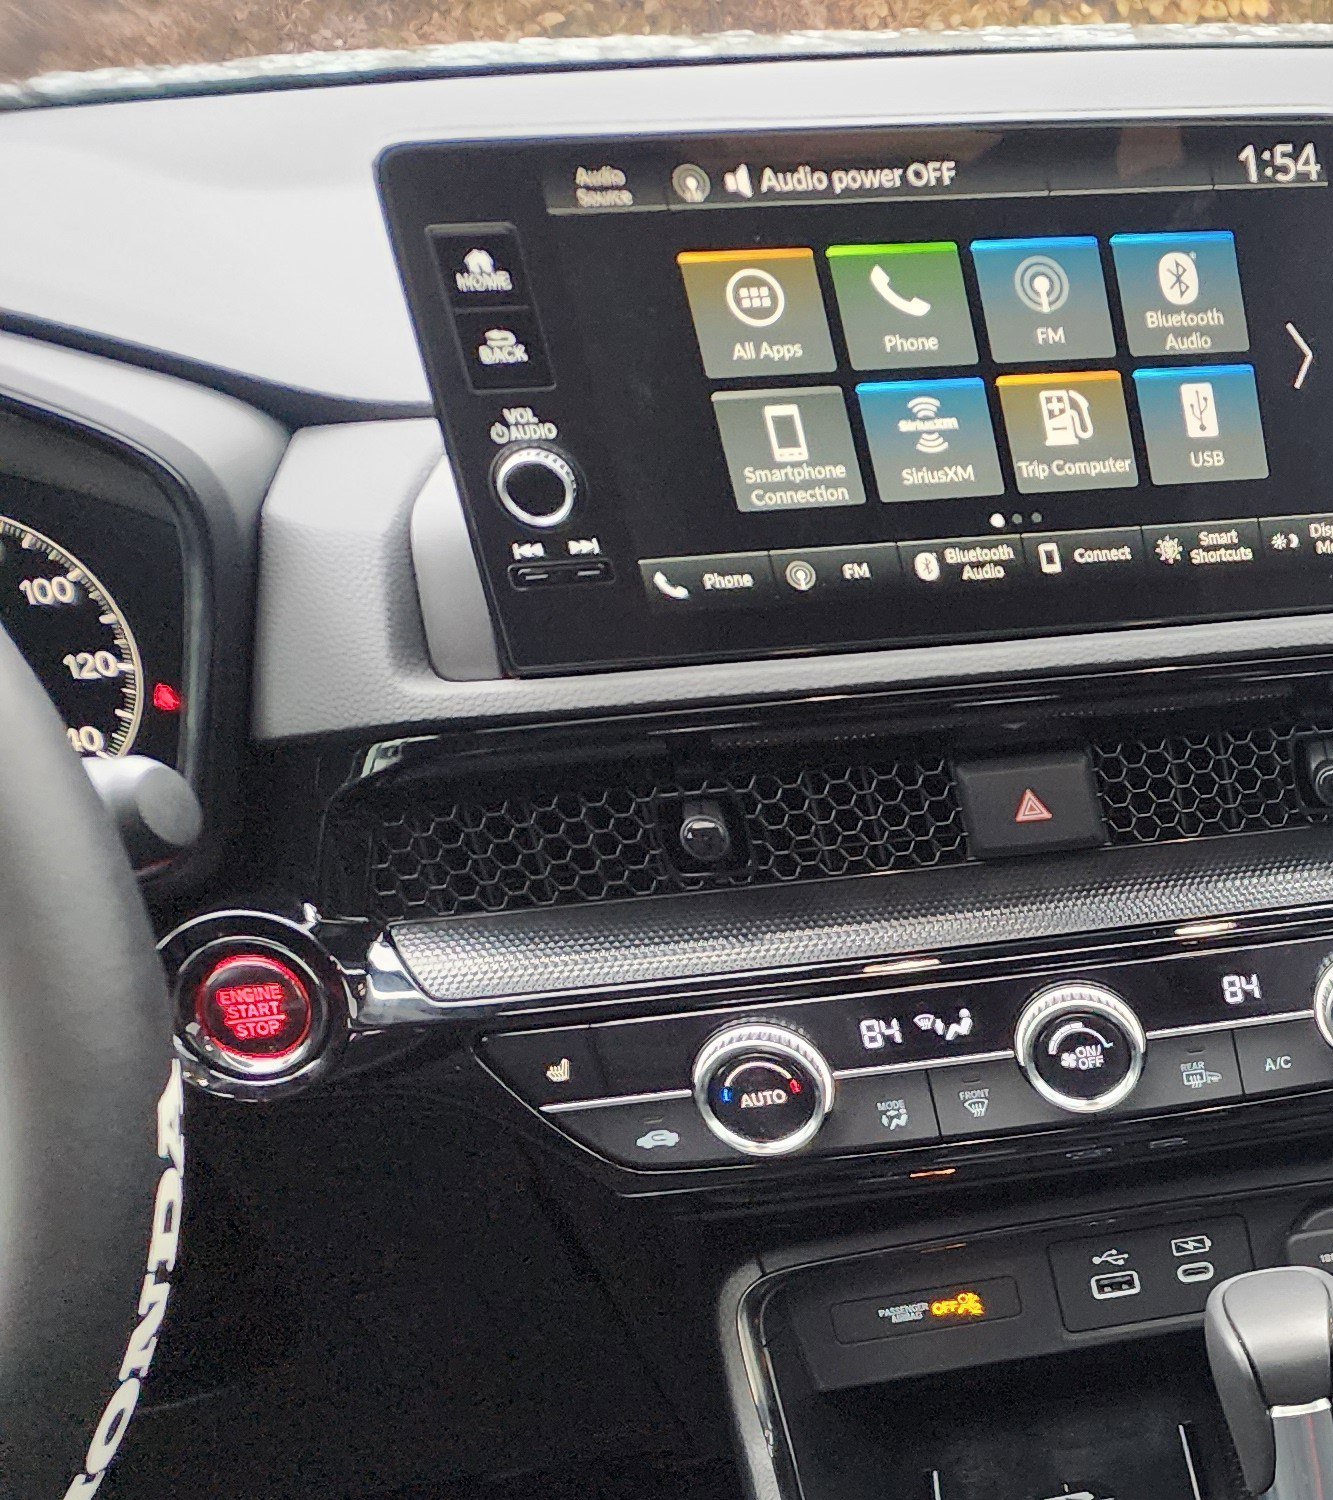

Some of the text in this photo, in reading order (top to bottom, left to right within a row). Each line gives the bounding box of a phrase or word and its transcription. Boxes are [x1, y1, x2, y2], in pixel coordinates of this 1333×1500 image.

[1238, 142, 1322, 184] 1:54
[576, 166, 626, 187] Audio
[761, 161, 956, 194] Audio power OFF
[456, 271, 512, 292] HOME
[1145, 309, 1225, 328] Bluetooth
[884, 334, 939, 353] Phone
[1036, 327, 1066, 345] FM
[1165, 331, 1212, 350] Audio
[479, 344, 529, 366] BACK
[733, 340, 803, 363] All Apps
[503, 407, 538, 425] VOL
[510, 421, 558, 442] AUDIO
[1190, 450, 1226, 468] USB
[744, 465, 846, 486] Smartphone
[901, 465, 975, 485] SiriusXM
[1018, 456, 1133, 483] Trip Computer
[751, 486, 849, 507] Connection
[1198, 529, 1239, 547] Smart
[944, 544, 1016, 564] Bluetooth
[1073, 546, 1133, 565] Connect
[1190, 546, 1254, 566] Shortcuts
[703, 571, 754, 591] Phone
[842, 563, 871, 581] FM
[960, 562, 1006, 581] Audio
[19, 576, 75, 605] 100
[63, 651, 119, 679] 120
[217, 983, 282, 1004] ENGINE
[1222, 973, 1263, 1005] 84
[226, 1000, 281, 1018] START
[235, 1020, 281, 1037] STOP
[860, 1017, 903, 1050] 84
[1078, 1054, 1105, 1071] OFF
[1181, 1060, 1206, 1073] REAR
[1265, 1056, 1292, 1072] A/C
[740, 1089, 787, 1109] AUTO
[959, 1087, 991, 1102] FRONT
[877, 1098, 906, 1112] MODE
[878, 1302, 929, 1317] PASSENGER
[931, 1300, 958, 1316] OFF
